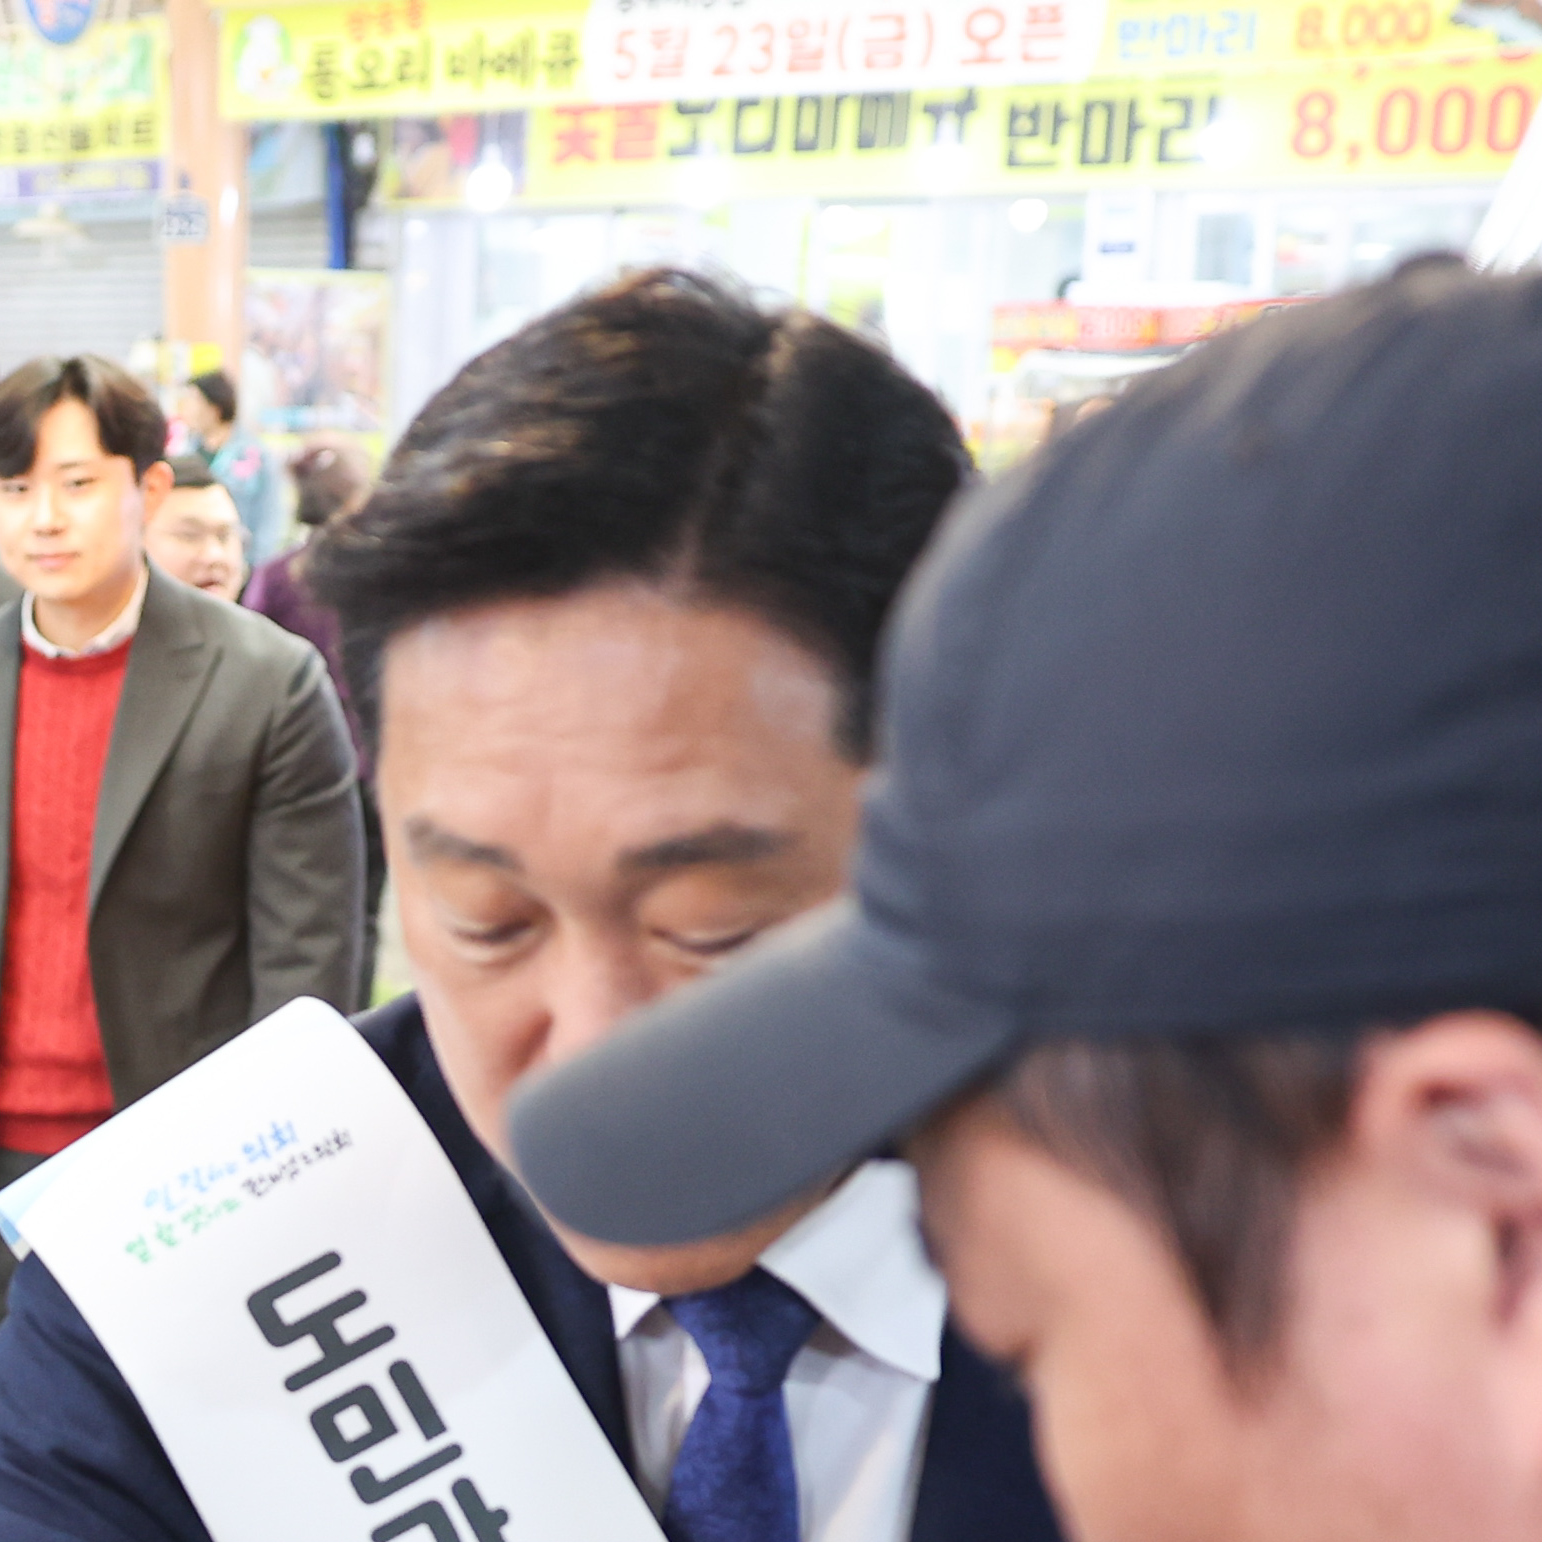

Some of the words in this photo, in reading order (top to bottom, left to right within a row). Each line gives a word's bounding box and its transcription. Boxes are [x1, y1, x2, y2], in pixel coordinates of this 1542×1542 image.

[613, 27, 690, 80] 5월
[710, 12, 934, 78] 23일(금)
[959, 5, 1066, 66] 오픈
[1294, 3, 1432, 53] 8,000
[1291, 84, 1531, 164] 8,000
[241, 1119, 299, 1164] 의회
